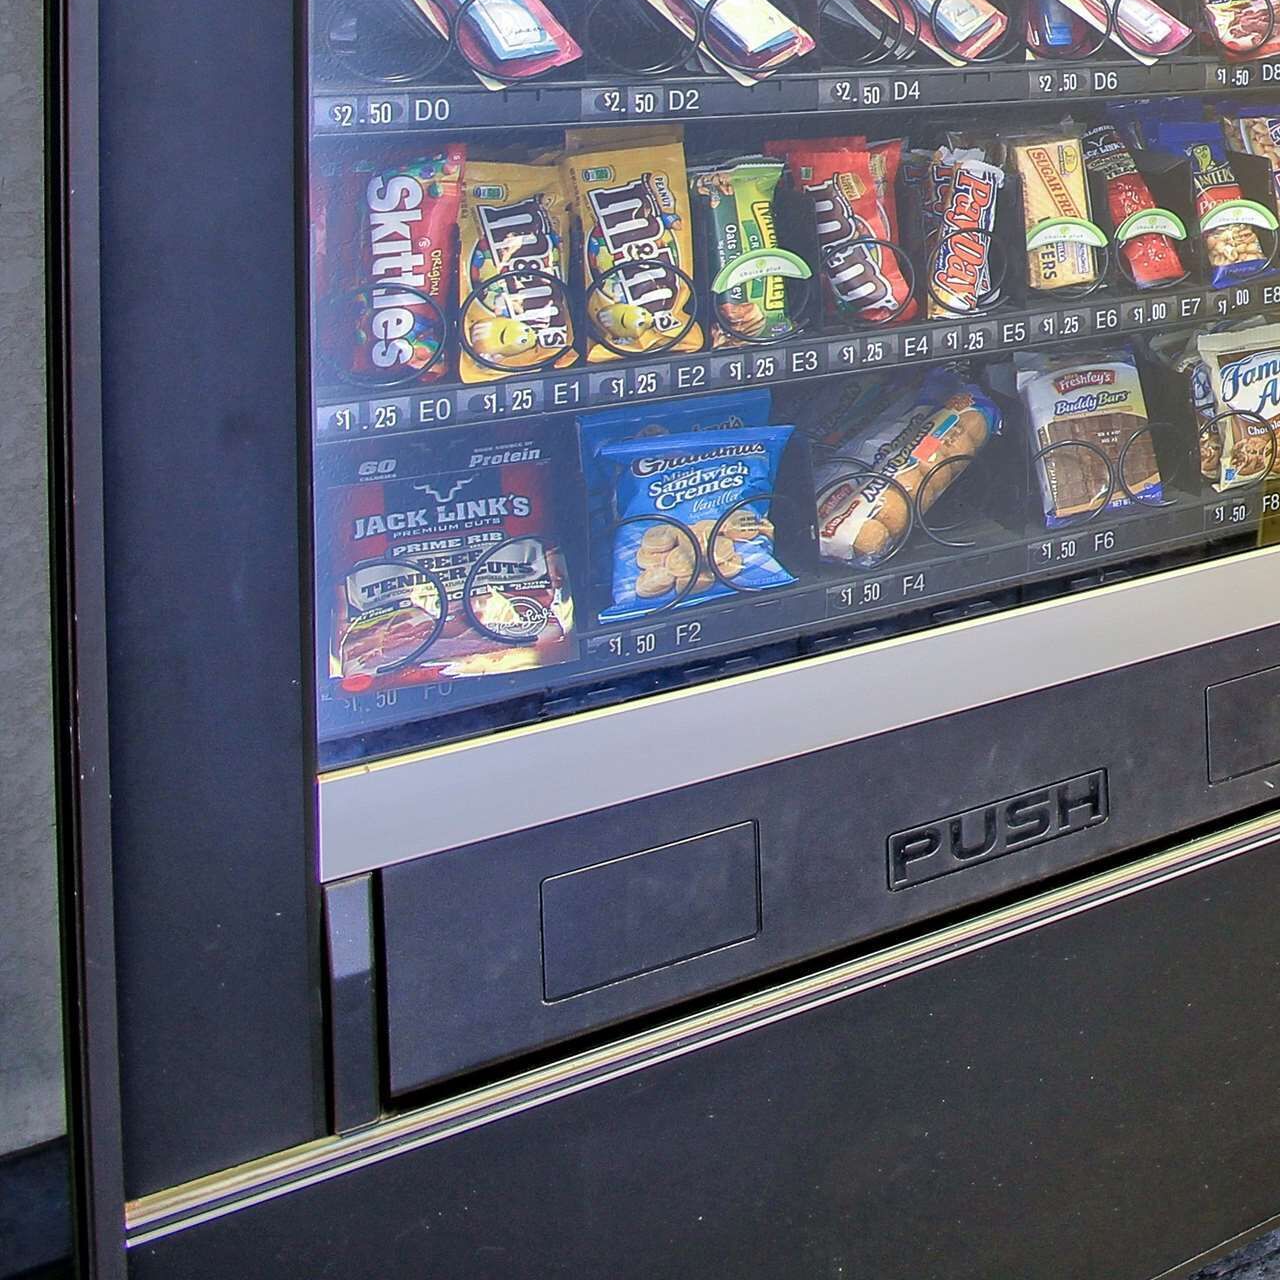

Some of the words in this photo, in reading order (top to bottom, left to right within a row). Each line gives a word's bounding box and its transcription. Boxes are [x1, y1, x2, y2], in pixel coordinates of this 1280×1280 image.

[836, 82, 880, 105] $2.50
[893, 80, 921, 101] D4
[1038, 73, 1078, 93] $2.50
[1094, 72, 1118, 91] D6
[334, 103, 391, 127] $2.50
[604, 91, 654, 113] $2.50
[668, 89, 700, 111] D2
[1031, 150, 1062, 193] SUGAR
[653, 176, 672, 209] PEANUT
[725, 224, 737, 250] Oats
[1043, 317, 1079, 336] $1.25
[1096, 309, 1118, 329] E6
[1134, 302, 1167, 323] $1.00
[1181, 298, 1201, 317] E7
[842, 344, 883, 364] $1.25
[904, 335, 929, 357] E4
[946, 330, 984, 350] $1.25
[1003, 322, 1026, 342] E5
[729, 358, 775, 382] $1.25
[792, 350, 819, 372] E3
[611, 373, 657, 399] $1.25
[677, 366, 705, 388] E2
[484, 390, 532, 414] $1.25
[553, 381, 580, 405] E1
[1055, 395, 1097, 415] Buddy
[1097, 390, 1128, 406] Bars
[336, 407, 397, 431] $1.25
[358, 458, 397, 476] 60
[469, 447, 541, 468] Protein
[649, 460, 749, 497] Sandwich
[655, 474, 745, 511] Cremes
[354, 510, 433, 540] JACK
[437, 494, 532, 524] LINK'S
[1215, 505, 1246, 523] $1.50
[1262, 493, 1280, 514] F8
[393, 523, 459, 539] PREMIUM
[464, 517, 501, 529] CUTS
[391, 537, 463, 558] PRIME
[467, 531, 504, 545] RIB
[1041, 540, 1076, 560] $1.50
[1094, 531, 1115, 552] F6
[841, 581, 880, 606] $1.50
[902, 573, 926, 596] F4
[609, 634, 656, 657] $1.50
[676, 622, 702, 644] F2
[893, 774, 1104, 885] PUSH
